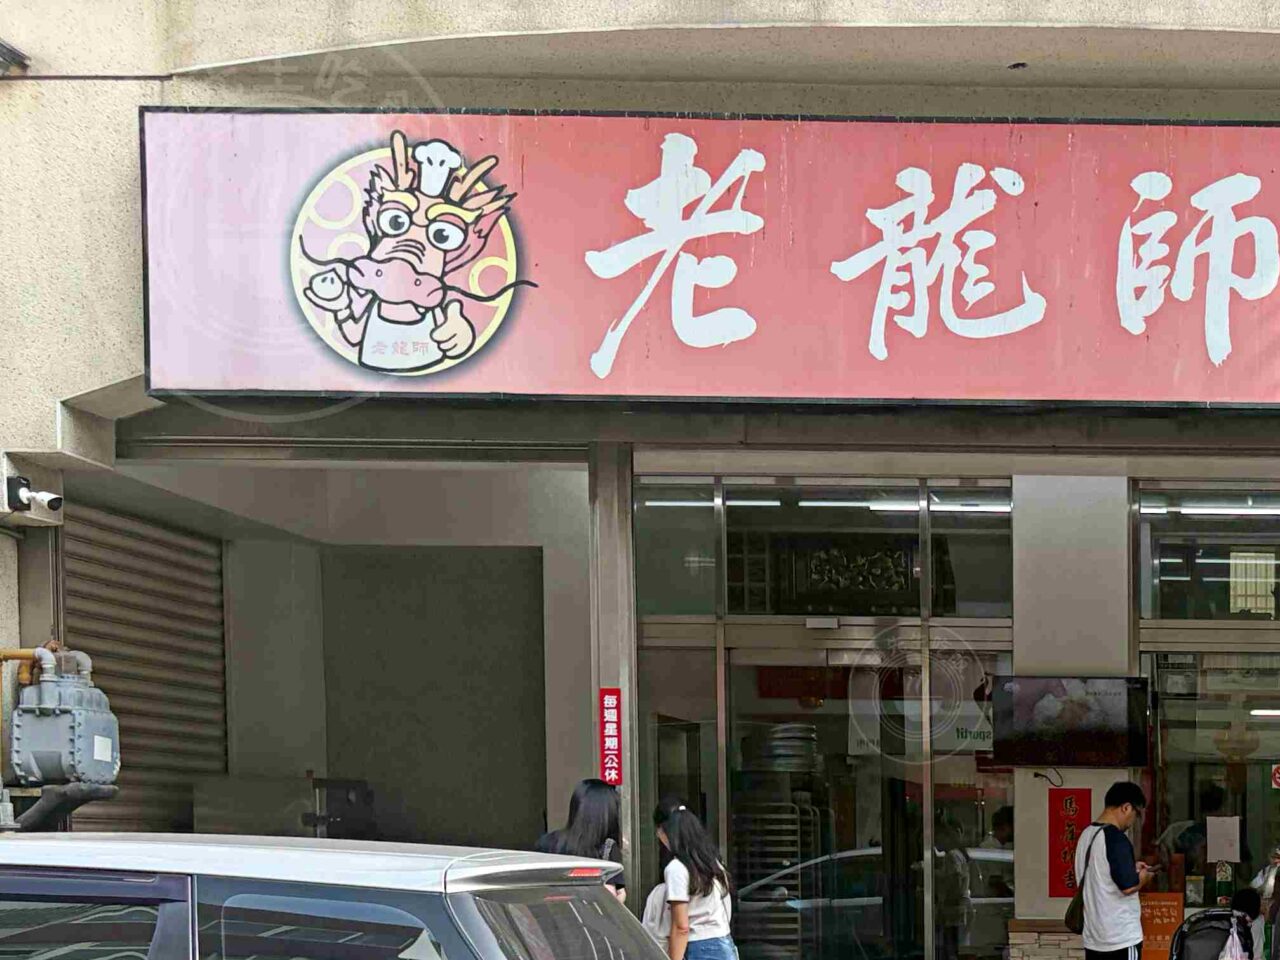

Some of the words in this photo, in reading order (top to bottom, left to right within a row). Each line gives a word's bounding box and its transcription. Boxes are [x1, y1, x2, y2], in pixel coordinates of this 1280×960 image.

[603, 695, 618, 781] 每週星期一公休
